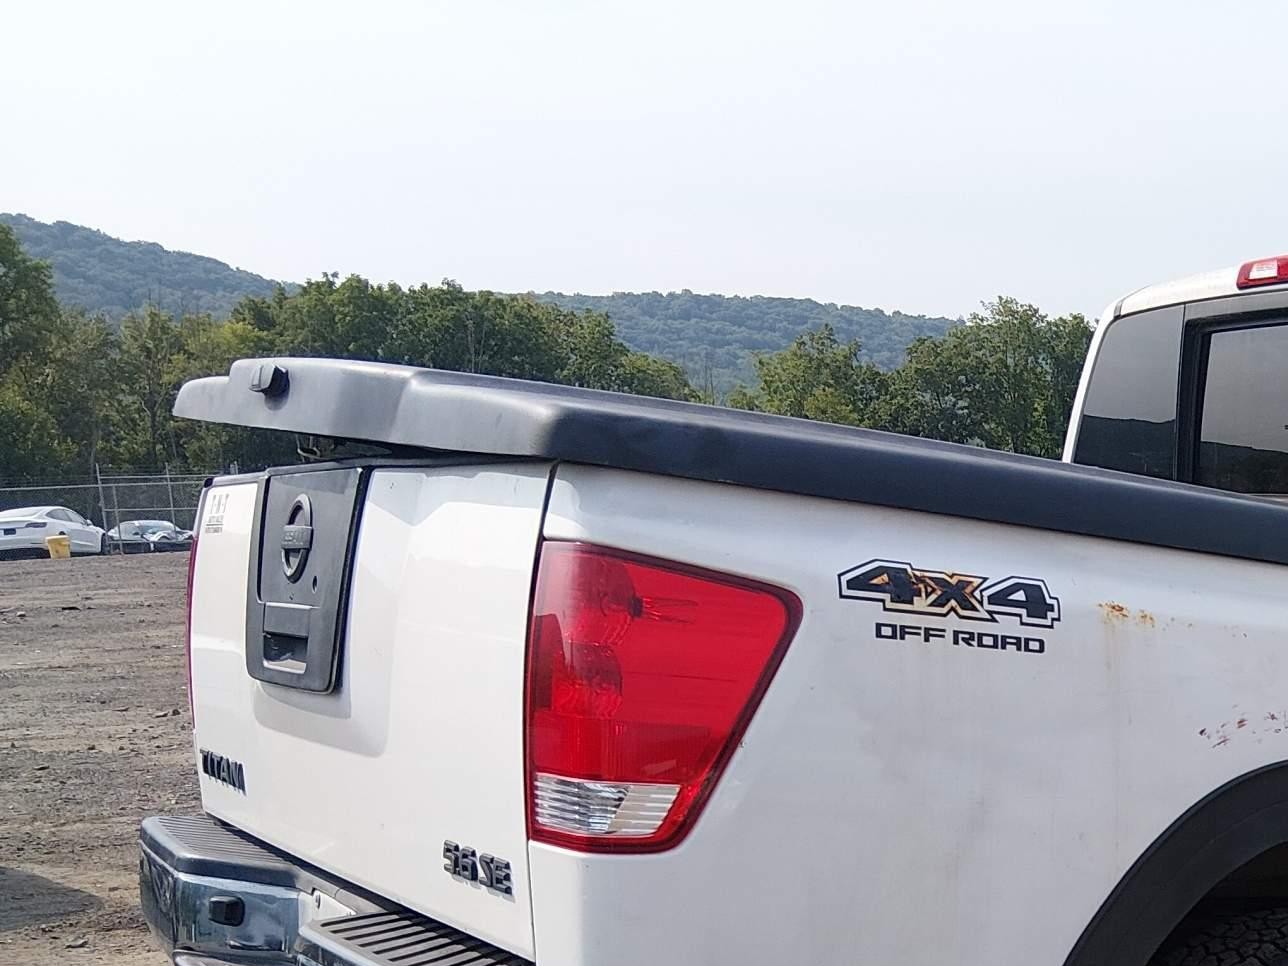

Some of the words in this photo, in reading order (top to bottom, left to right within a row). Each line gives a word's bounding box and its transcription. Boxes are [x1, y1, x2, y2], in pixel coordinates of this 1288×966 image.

[875, 622, 946, 643] OFF
[952, 629, 1045, 654] ROAD
[200, 749, 246, 796] TITAN
[478, 852, 513, 896] SE
